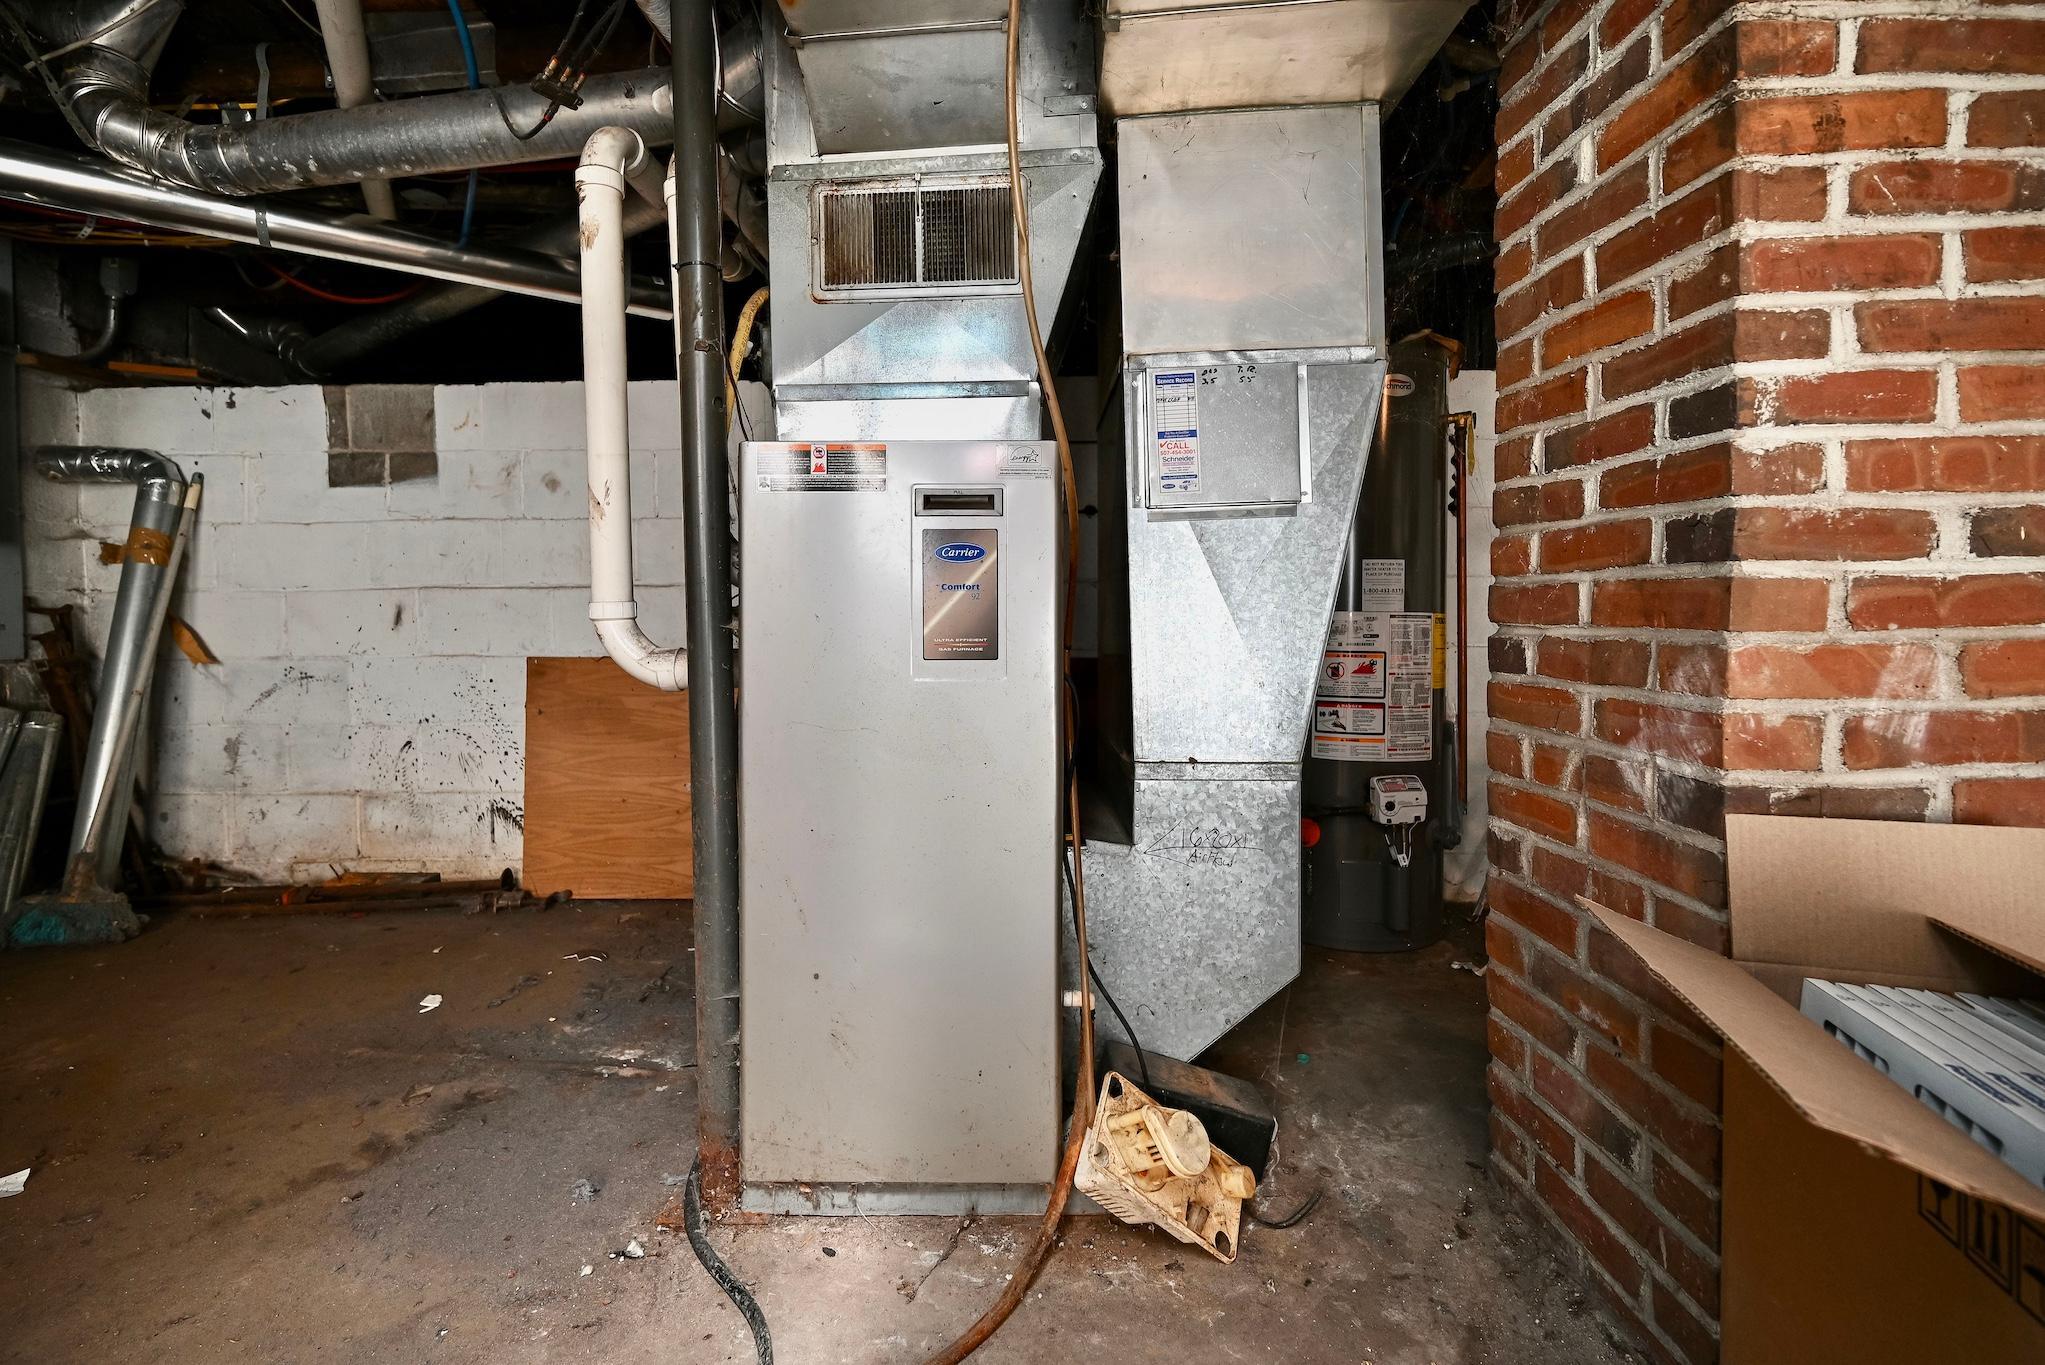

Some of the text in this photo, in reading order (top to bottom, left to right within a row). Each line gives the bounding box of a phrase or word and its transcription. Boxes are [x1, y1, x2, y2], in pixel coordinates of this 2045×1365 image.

[1166, 442, 1190, 450] CALL
[941, 547, 981, 558] Carrier
[941, 583, 981, 591] Comfort
[971, 592, 981, 600] 92
